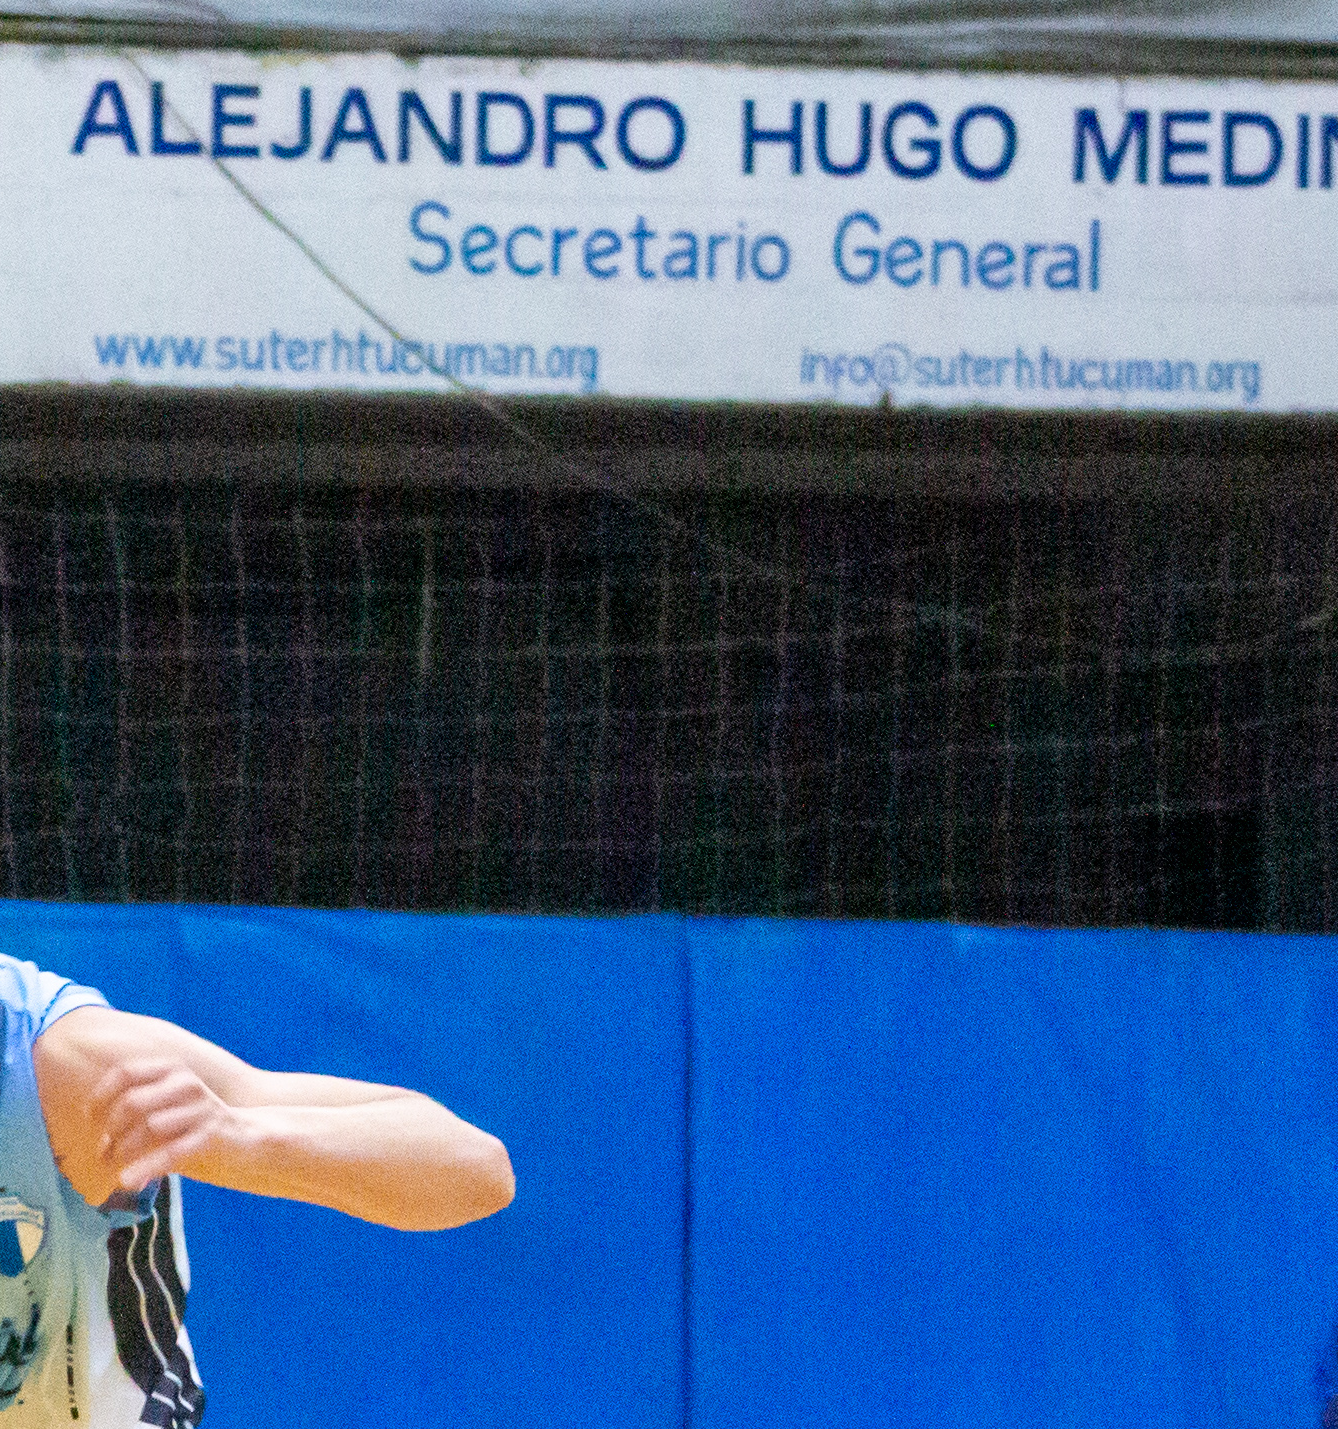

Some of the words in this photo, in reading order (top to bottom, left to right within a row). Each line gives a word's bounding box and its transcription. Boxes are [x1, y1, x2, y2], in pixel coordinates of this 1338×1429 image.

[70, 79, 688, 172] ALEJANDRO
[741, 98, 1018, 182] HUGO
[407, 200, 791, 283] Secretario
[832, 209, 1102, 292] General
[94, 329, 599, 392] www.suterhtucuman.org
[799, 343, 1261, 403] info@suterhtucuman.org
